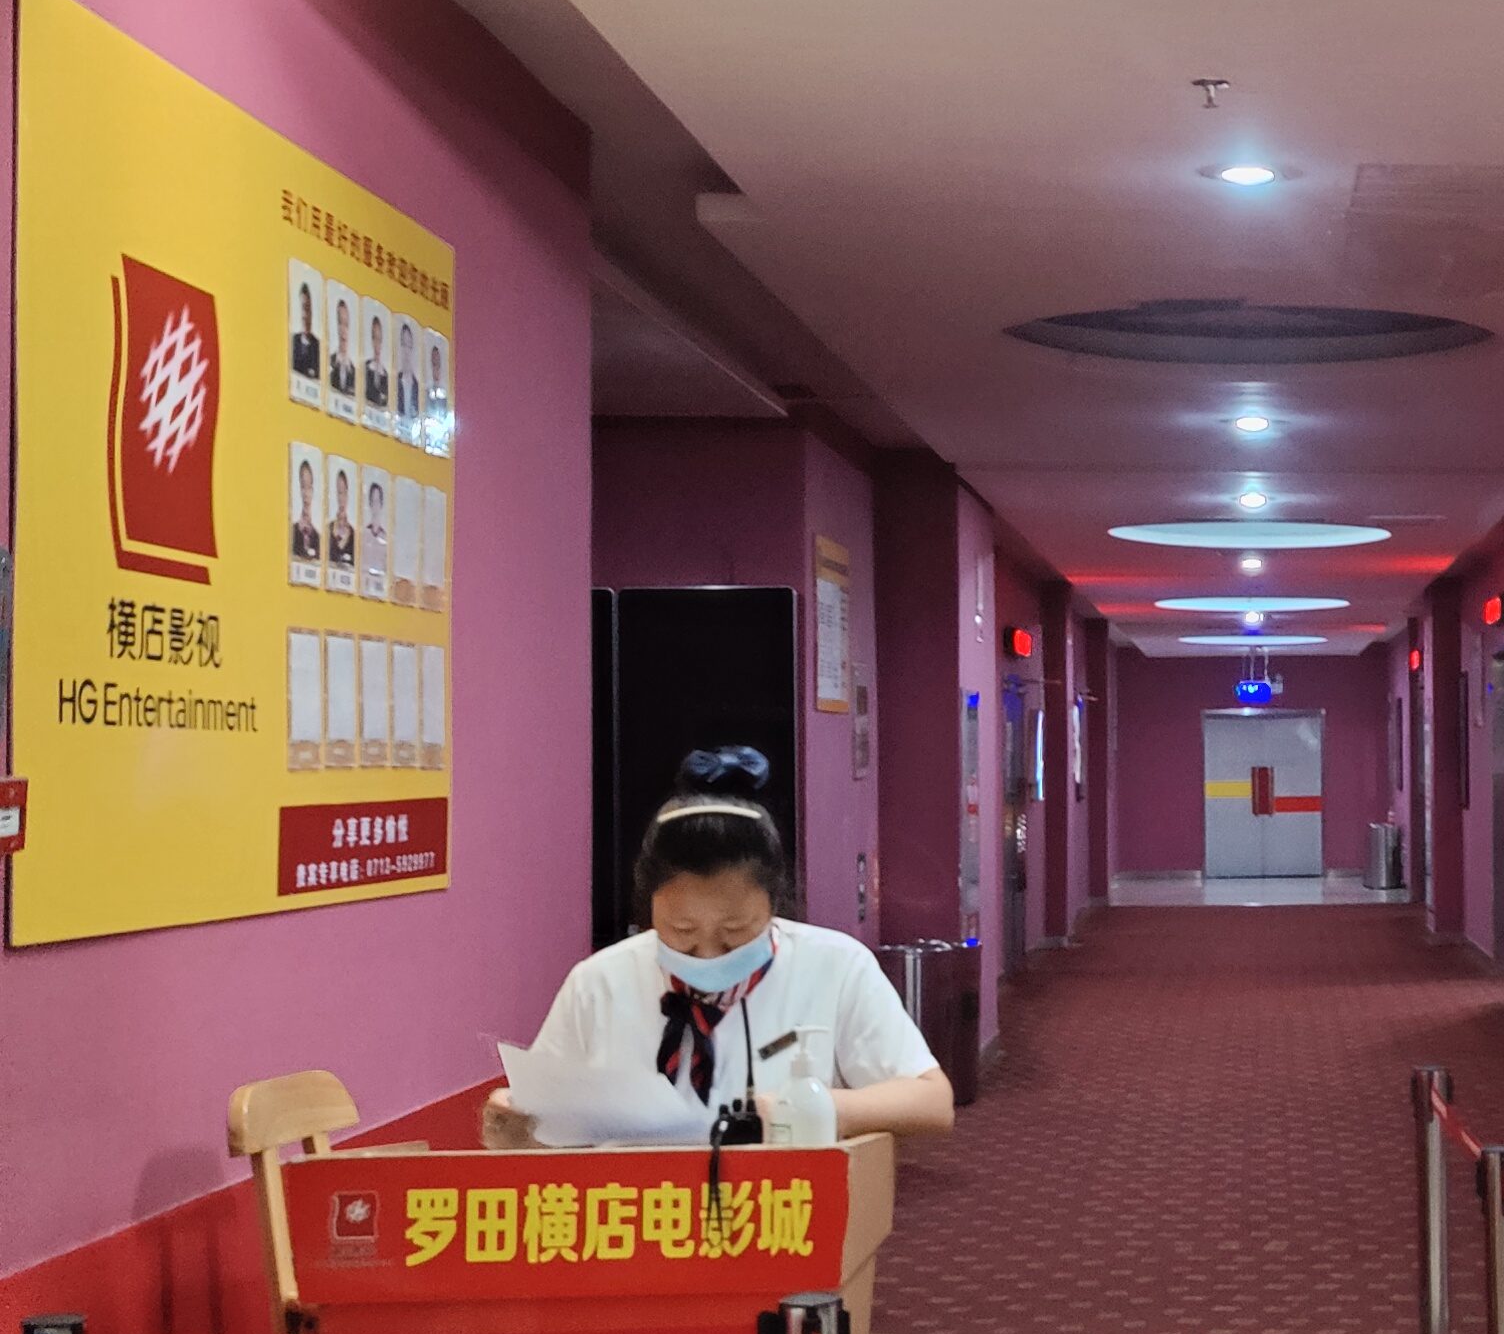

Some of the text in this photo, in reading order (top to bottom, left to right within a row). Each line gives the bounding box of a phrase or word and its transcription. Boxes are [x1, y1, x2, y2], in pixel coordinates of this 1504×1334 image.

[106, 596, 223, 669] 横店影视
[58, 678, 259, 733] HG Entertainment
[405, 1178, 813, 1267] 罗田横店电影城
